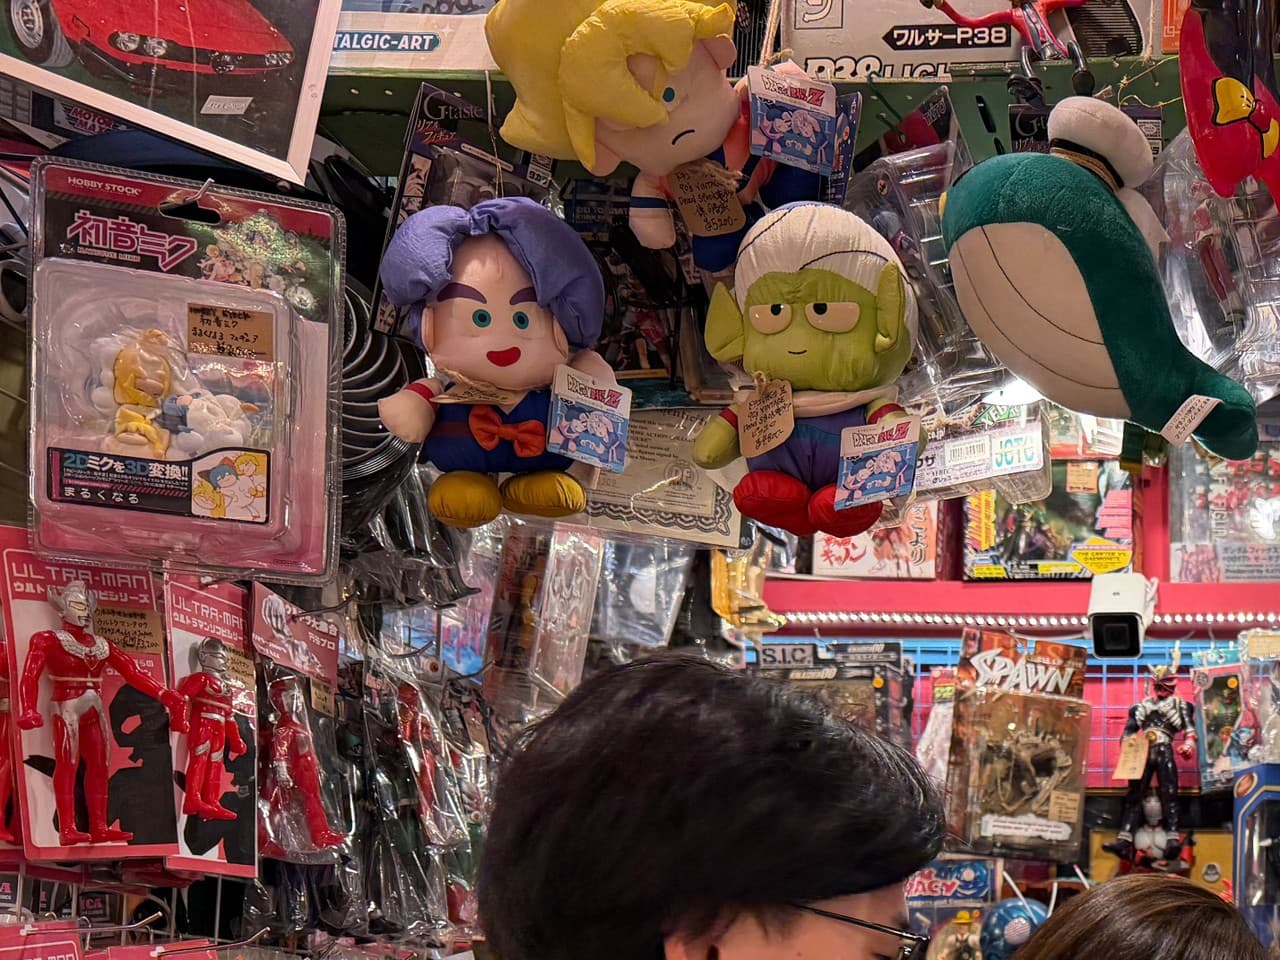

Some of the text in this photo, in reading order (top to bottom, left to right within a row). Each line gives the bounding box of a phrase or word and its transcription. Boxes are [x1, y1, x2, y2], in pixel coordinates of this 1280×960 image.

[892, 26, 1007, 46] ワルサーP.38
[71, 106, 113, 129] MOTOR
[67, 176, 143, 196] HOBBY STOCK
[66, 208, 198, 272] 初音ミク
[63, 486, 140, 505] まるくなる
[12, 562, 147, 590] ULTRA-MAN
[762, 647, 812, 664] S.I.C.
[969, 647, 1075, 695] SPAWN
